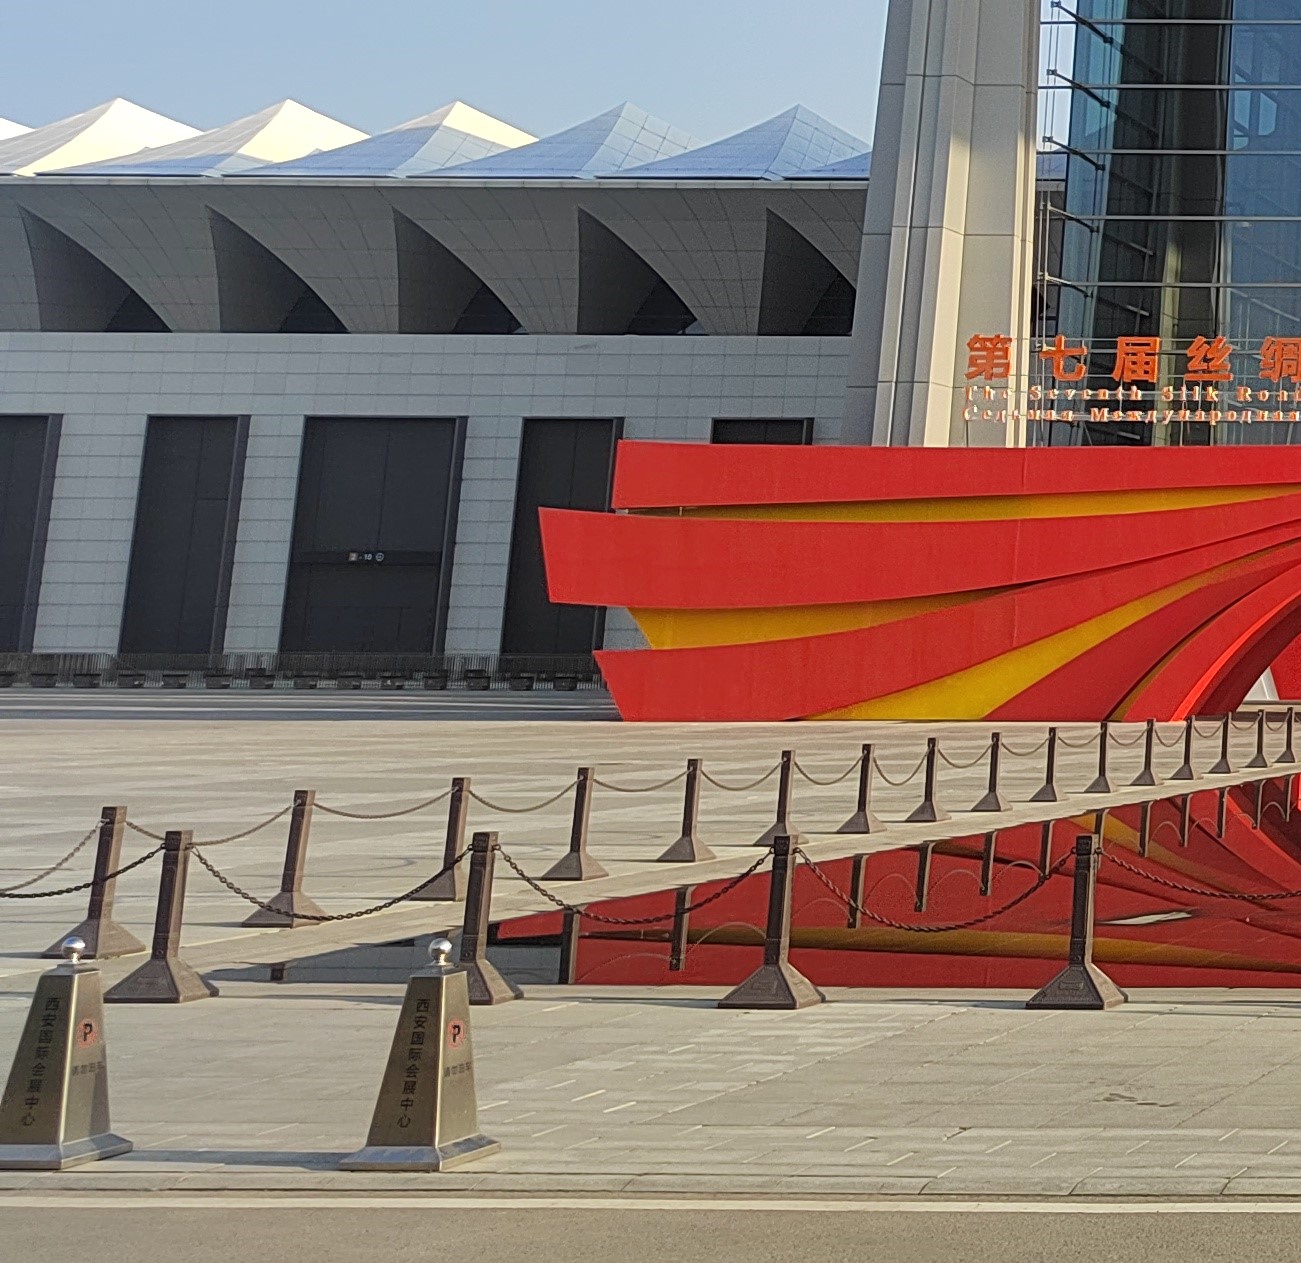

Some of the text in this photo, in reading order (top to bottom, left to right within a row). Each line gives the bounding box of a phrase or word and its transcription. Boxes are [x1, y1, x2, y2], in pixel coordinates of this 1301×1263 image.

[965, 385, 1012, 401] The
[1029, 385, 1142, 402] Seventh
[1161, 386, 1219, 402] Silk
[22, 997, 60, 1126] 西安国际会展中心
[397, 998, 430, 1128] 西安国际会展中心
